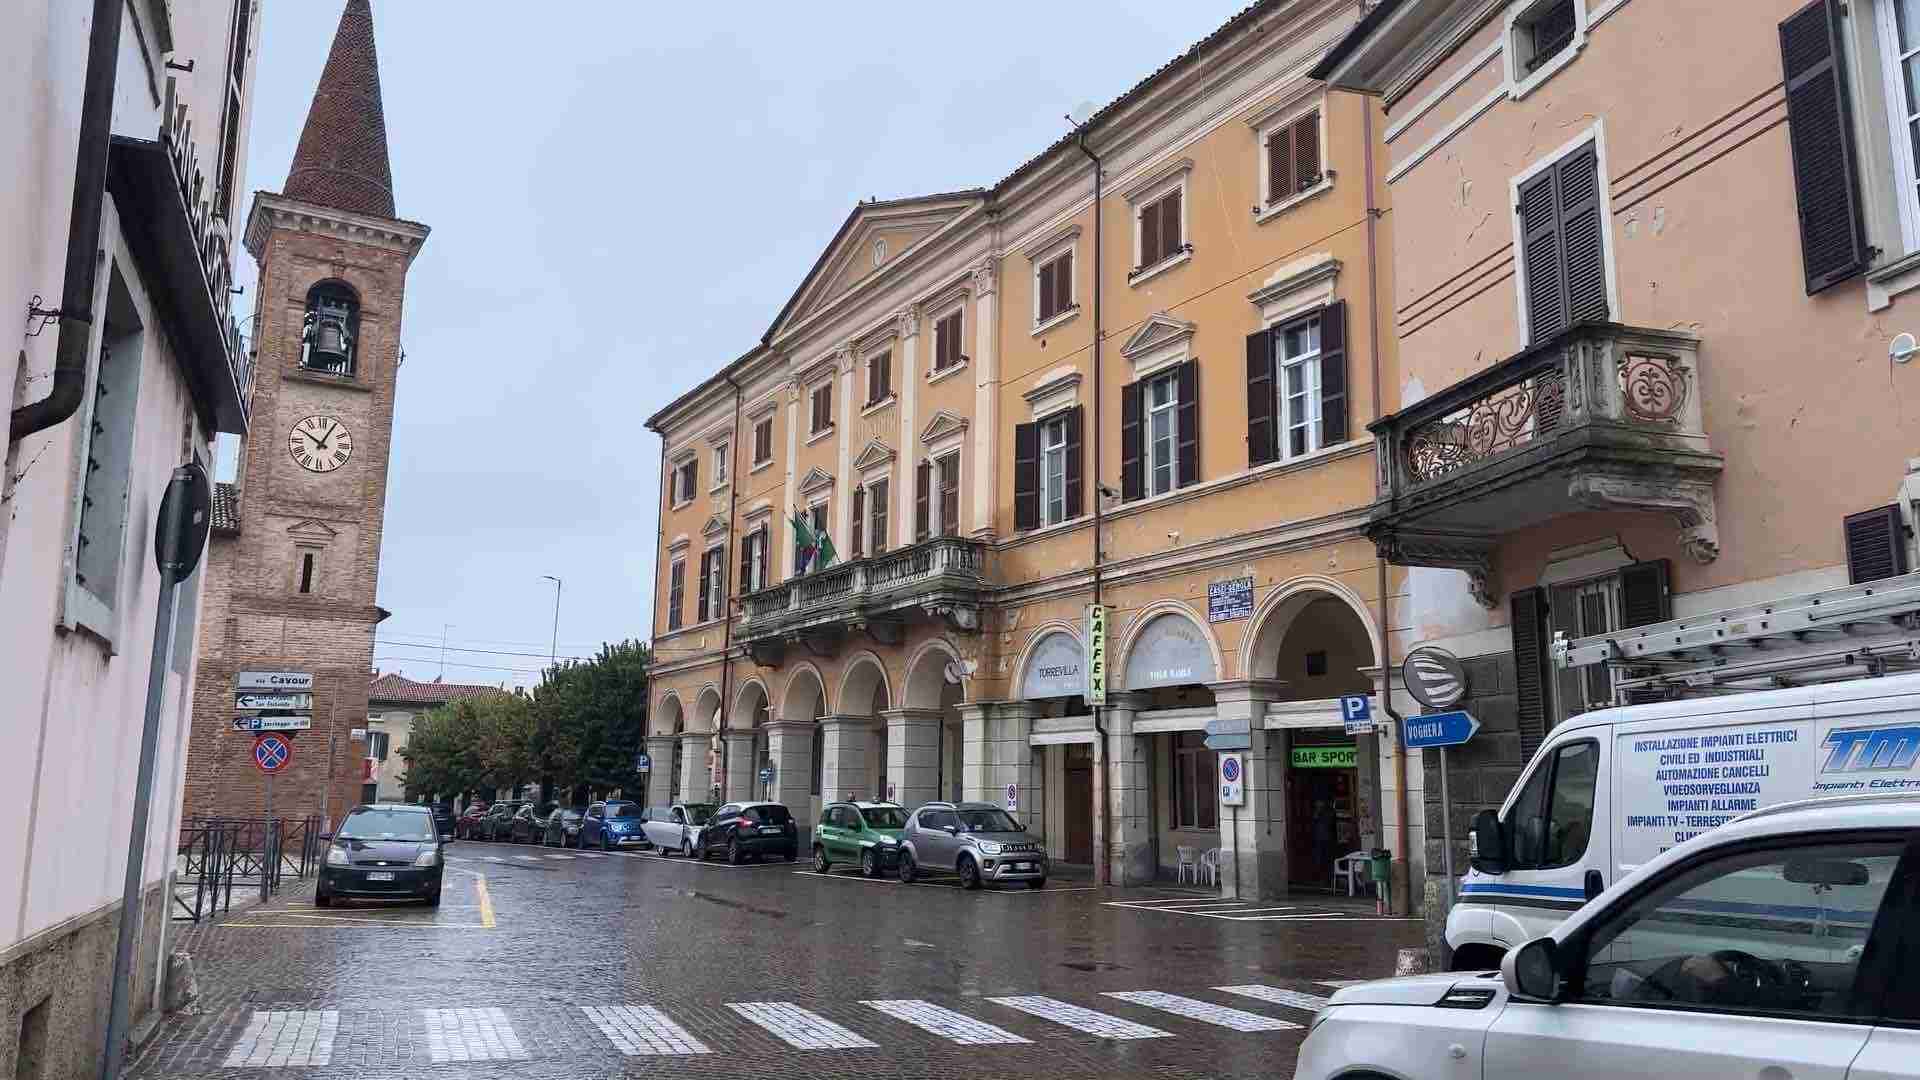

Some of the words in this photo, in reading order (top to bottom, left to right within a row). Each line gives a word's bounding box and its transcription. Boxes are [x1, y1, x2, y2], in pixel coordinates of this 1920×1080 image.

[1039, 664, 1080, 679] TORREVILLA
[271, 675, 311, 685] Cavour
[1346, 697, 1364, 719] P
[251, 719, 260, 728] P
[1407, 721, 1444, 739] VOGHERA
[1634, 737, 1699, 752] INSTALLAZIONE
[1701, 734, 1744, 749] IMPIANTI
[1746, 730, 1798, 745] ELETTRICI
[1294, 751, 1317, 763] BAR
[1660, 754, 1686, 766] CIVILI
[1688, 752, 1700, 764] ED
[1705, 749, 1764, 763] INDUSTRIALI
[1656, 768, 1719, 782] AUTOMAZIONE
[1722, 765, 1769, 779] CANCELLI
[1664, 782, 1760, 796] VIDEOSORVEGLIANZA
[1668, 799, 1708, 811] IMPIANTI
[1711, 799, 1757, 811] ALLARME
[1627, 815, 1665, 827] IMPIANTI
[1667, 815, 1678, 827] TV
